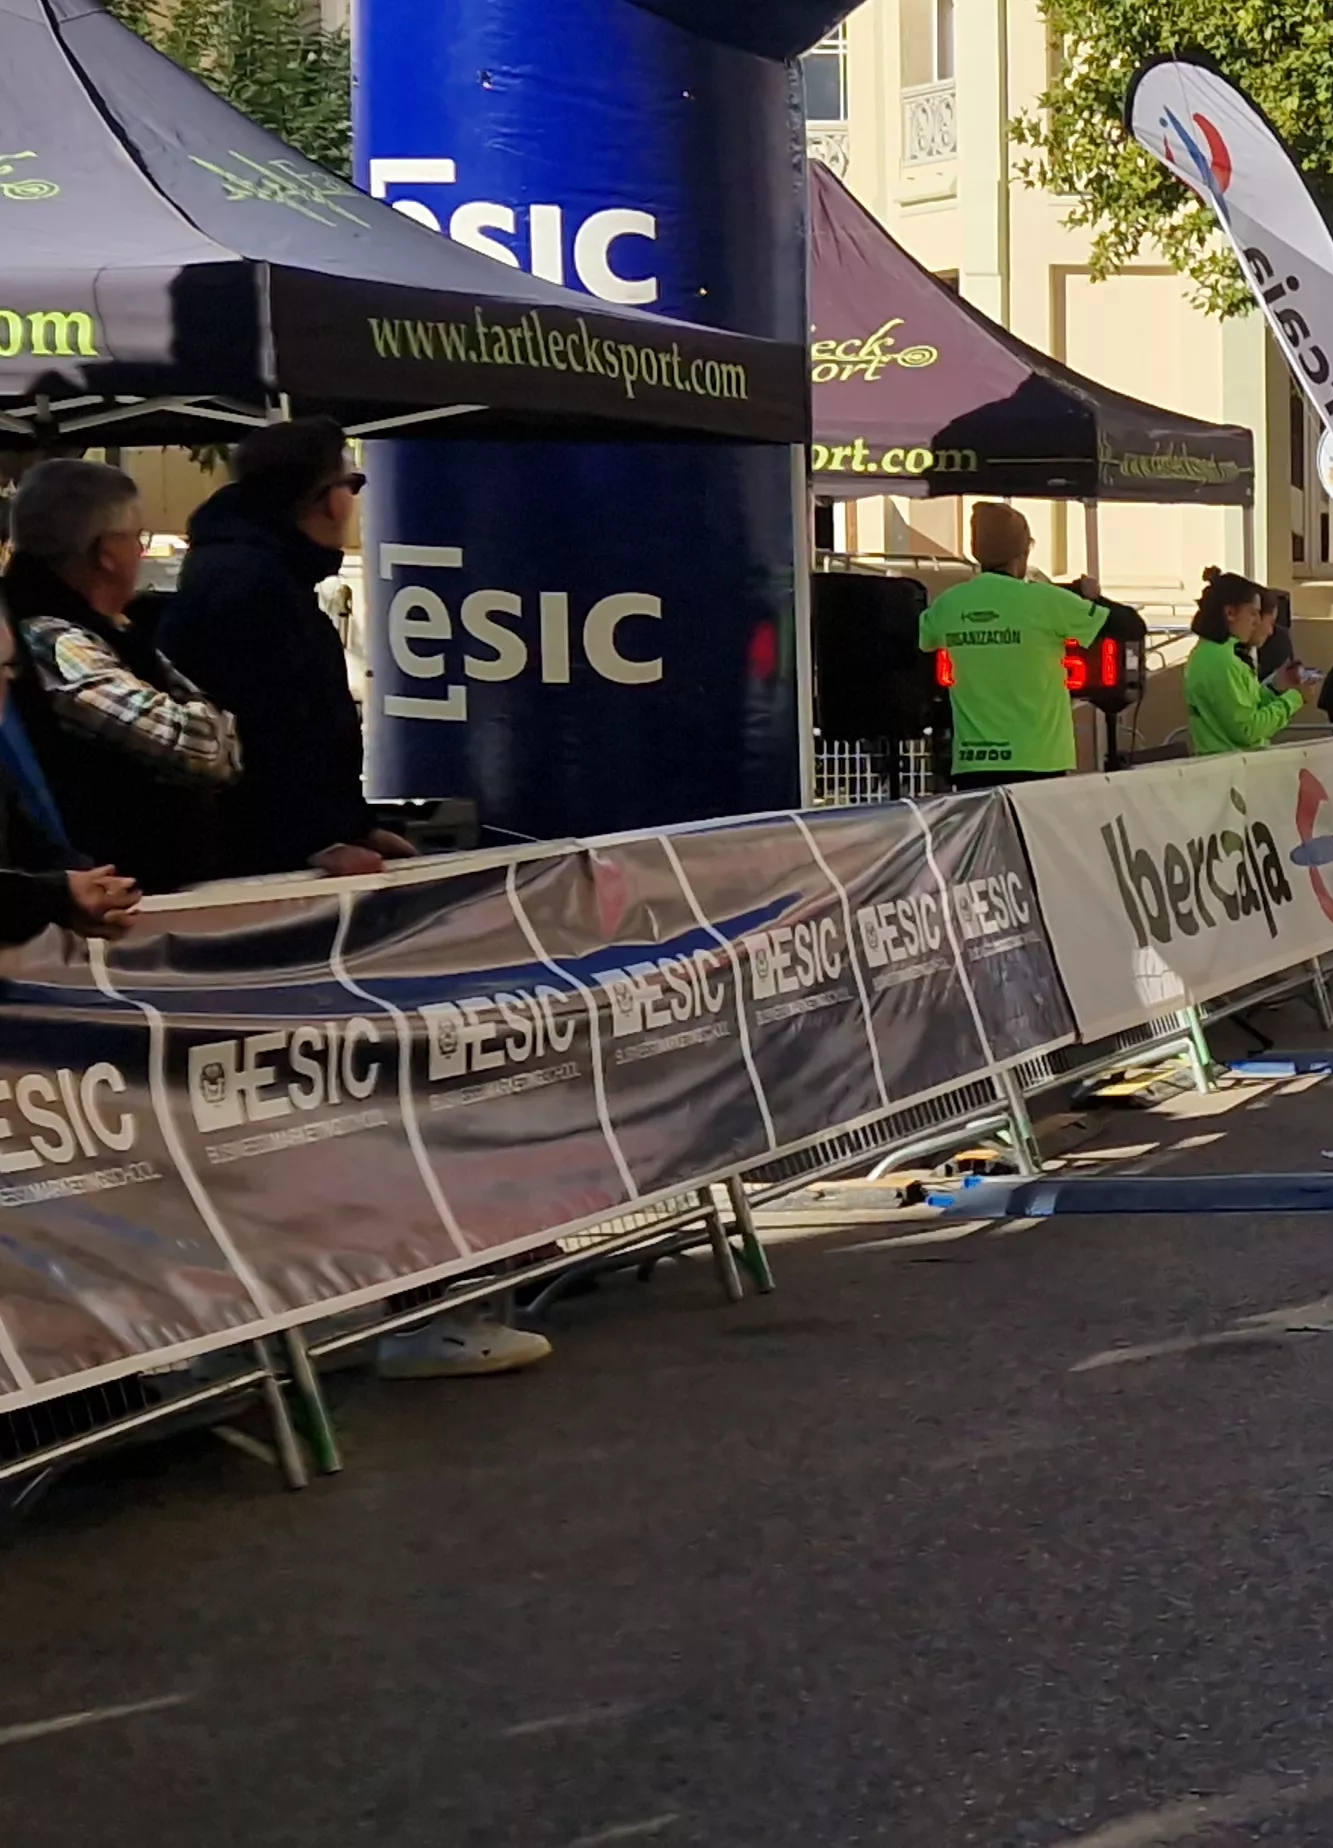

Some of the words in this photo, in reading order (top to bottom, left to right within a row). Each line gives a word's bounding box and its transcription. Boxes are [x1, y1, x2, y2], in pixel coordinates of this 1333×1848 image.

[366, 305, 749, 399] www.fartlecksport.com
[811, 318, 905, 361] eck
[972, 871, 1031, 938] ESIC
[1100, 787, 1293, 949] Ibercaja
[769, 917, 842, 996] ESIC
[877, 894, 942, 963] ESIC
[466, 984, 576, 1073] ESIC
[632, 947, 726, 1029] ESIC
[245, 1016, 382, 1122] ESIC
